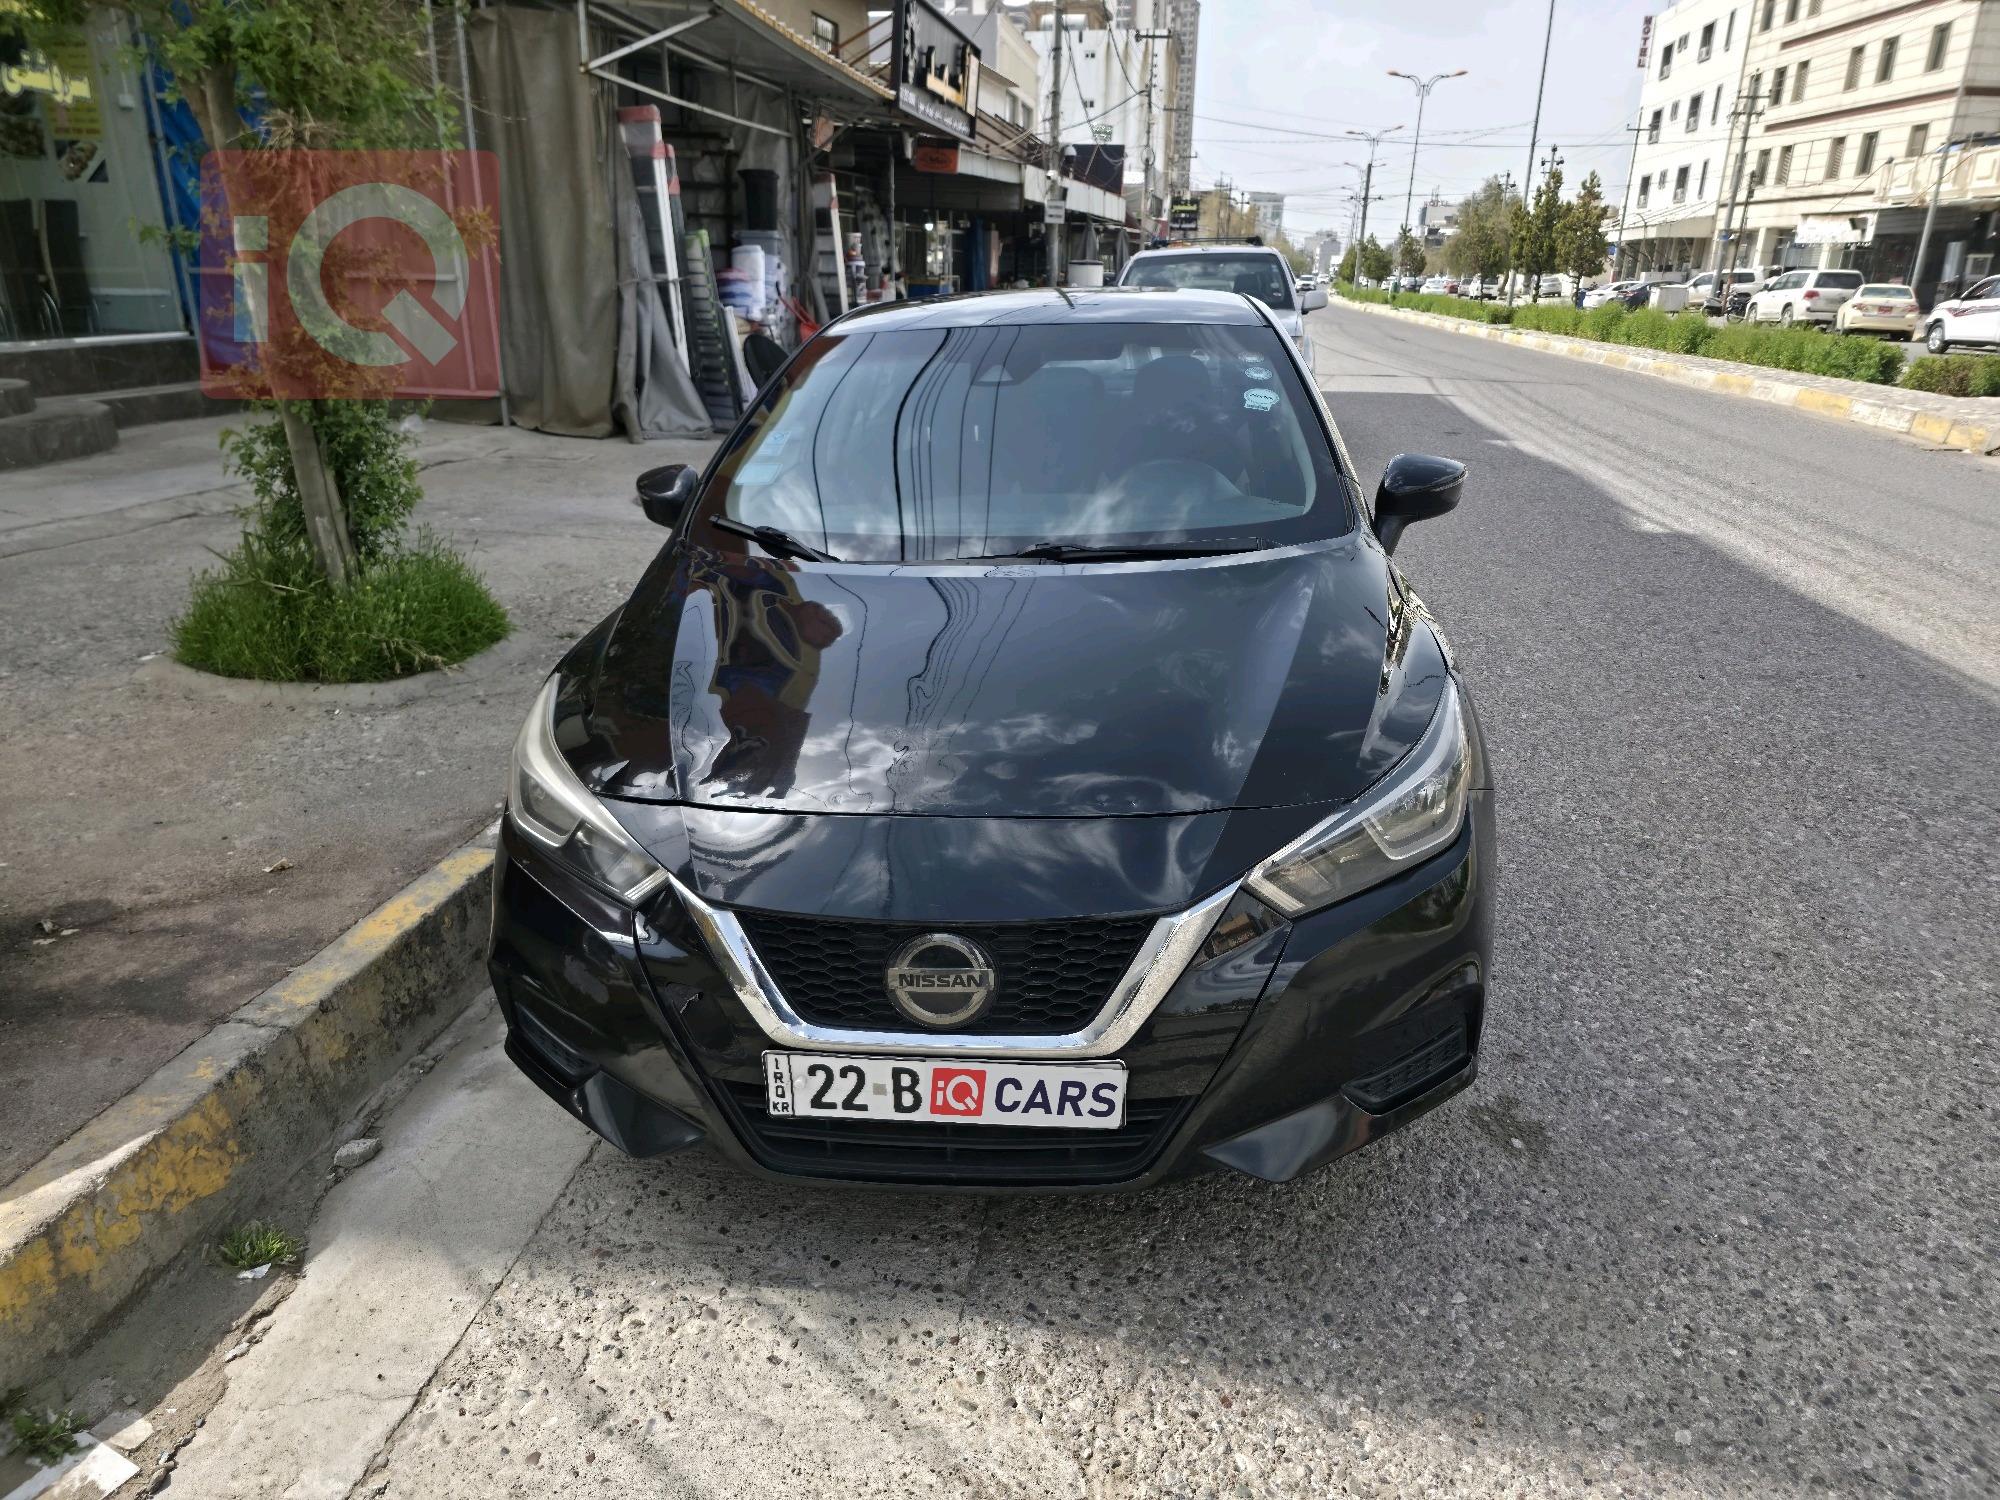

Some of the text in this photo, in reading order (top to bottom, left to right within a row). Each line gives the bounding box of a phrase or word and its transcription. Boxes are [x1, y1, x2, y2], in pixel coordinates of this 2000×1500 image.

[898, 973, 982, 988] NISSAN
[807, 1063, 923, 1114] 22 B
[772, 1101, 790, 1113] KR
